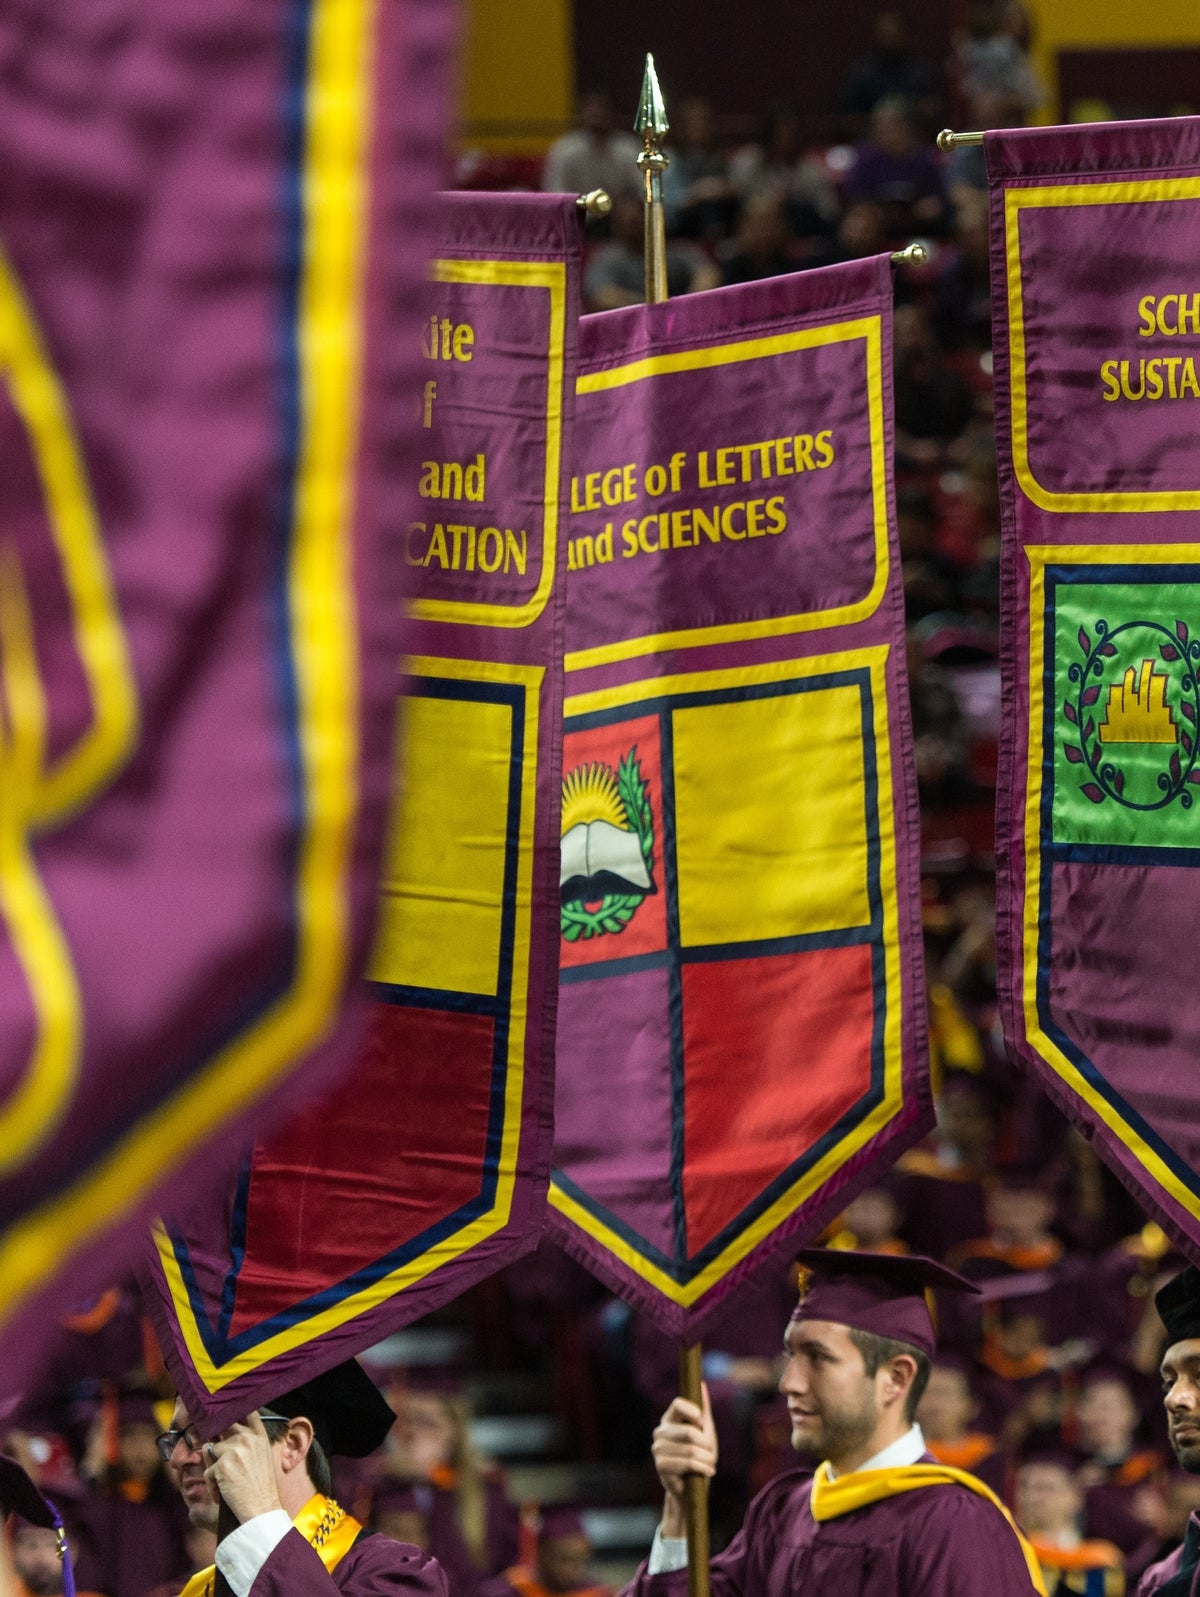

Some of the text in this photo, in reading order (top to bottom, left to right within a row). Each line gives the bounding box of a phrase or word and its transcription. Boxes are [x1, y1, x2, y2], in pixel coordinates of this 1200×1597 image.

[418, 453, 486, 502] and
[644, 452, 687, 497] of
[697, 430, 835, 489] LETTERS
[621, 496, 787, 558] SCIENCES
